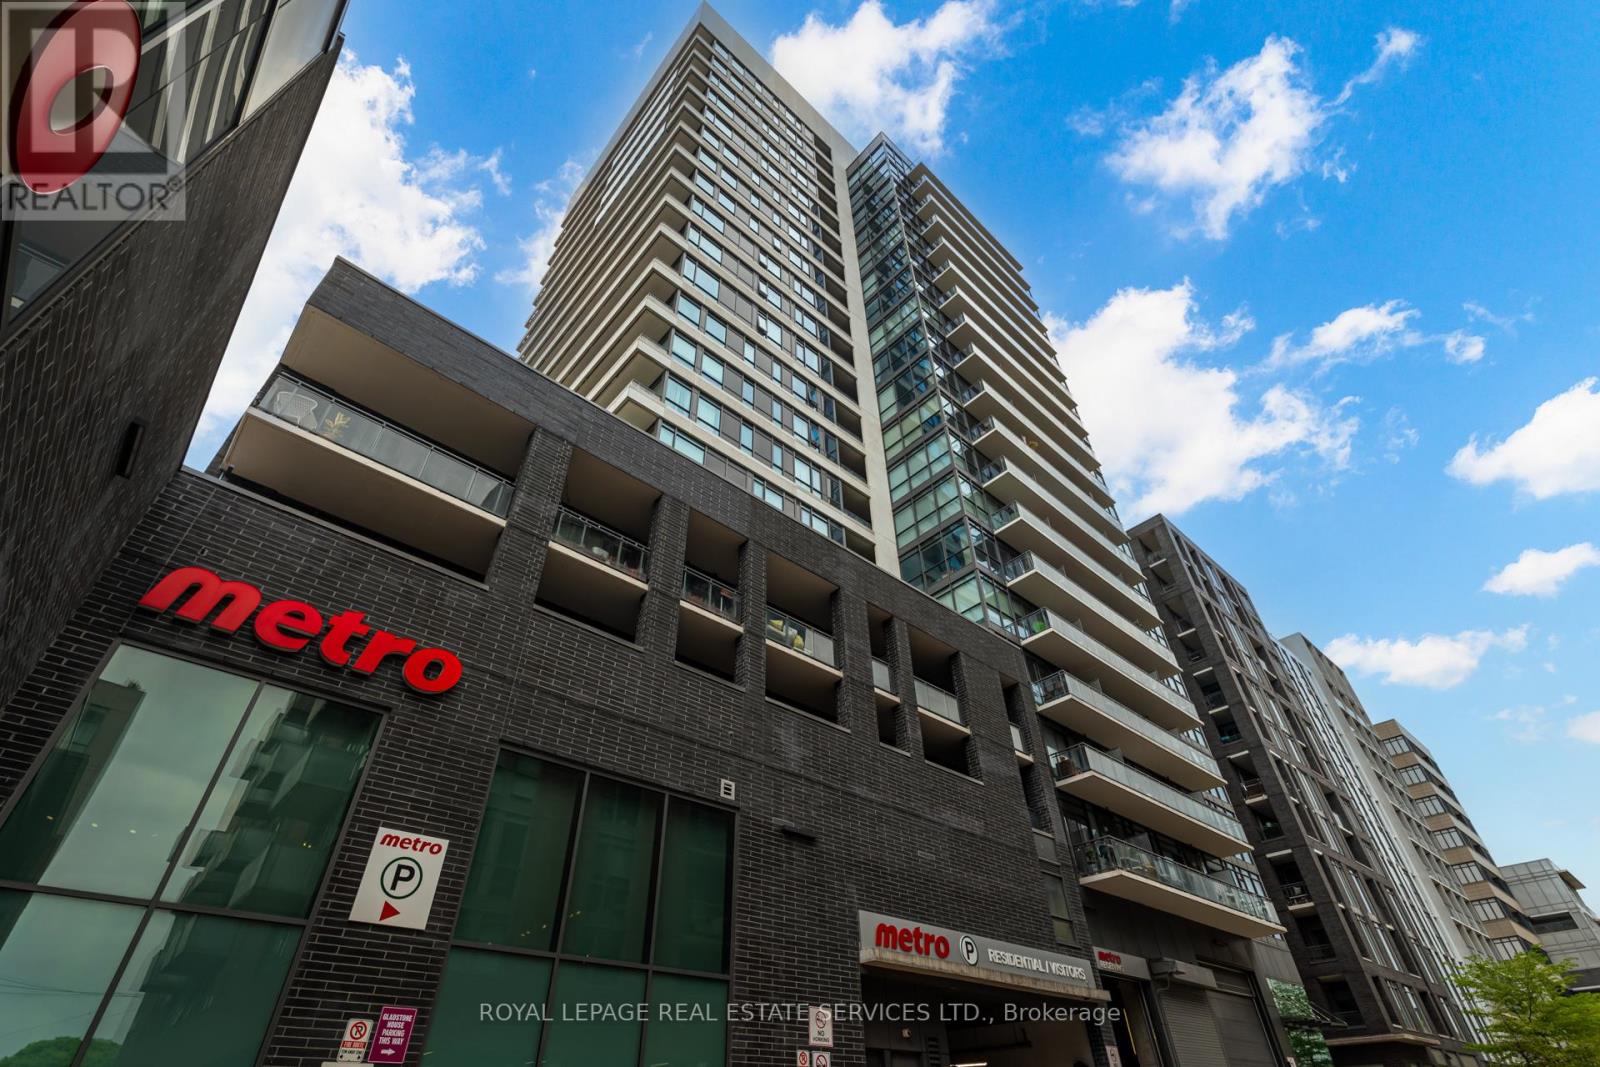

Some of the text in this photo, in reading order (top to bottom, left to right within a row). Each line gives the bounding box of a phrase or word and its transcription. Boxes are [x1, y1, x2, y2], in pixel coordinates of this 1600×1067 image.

[138, 565, 463, 695] metro
[379, 833, 443, 856] metro
[875, 922, 950, 959] metro
[987, 948, 1045, 973] RESIDENTIAL
[1049, 961, 1087, 980] VISITORS
[383, 1013, 413, 1022] GLADSTONE
[387, 1021, 405, 1029] HOUSE
[379, 1037, 405, 1045] THIS WAY
[382, 1029, 405, 1037] PARKING
